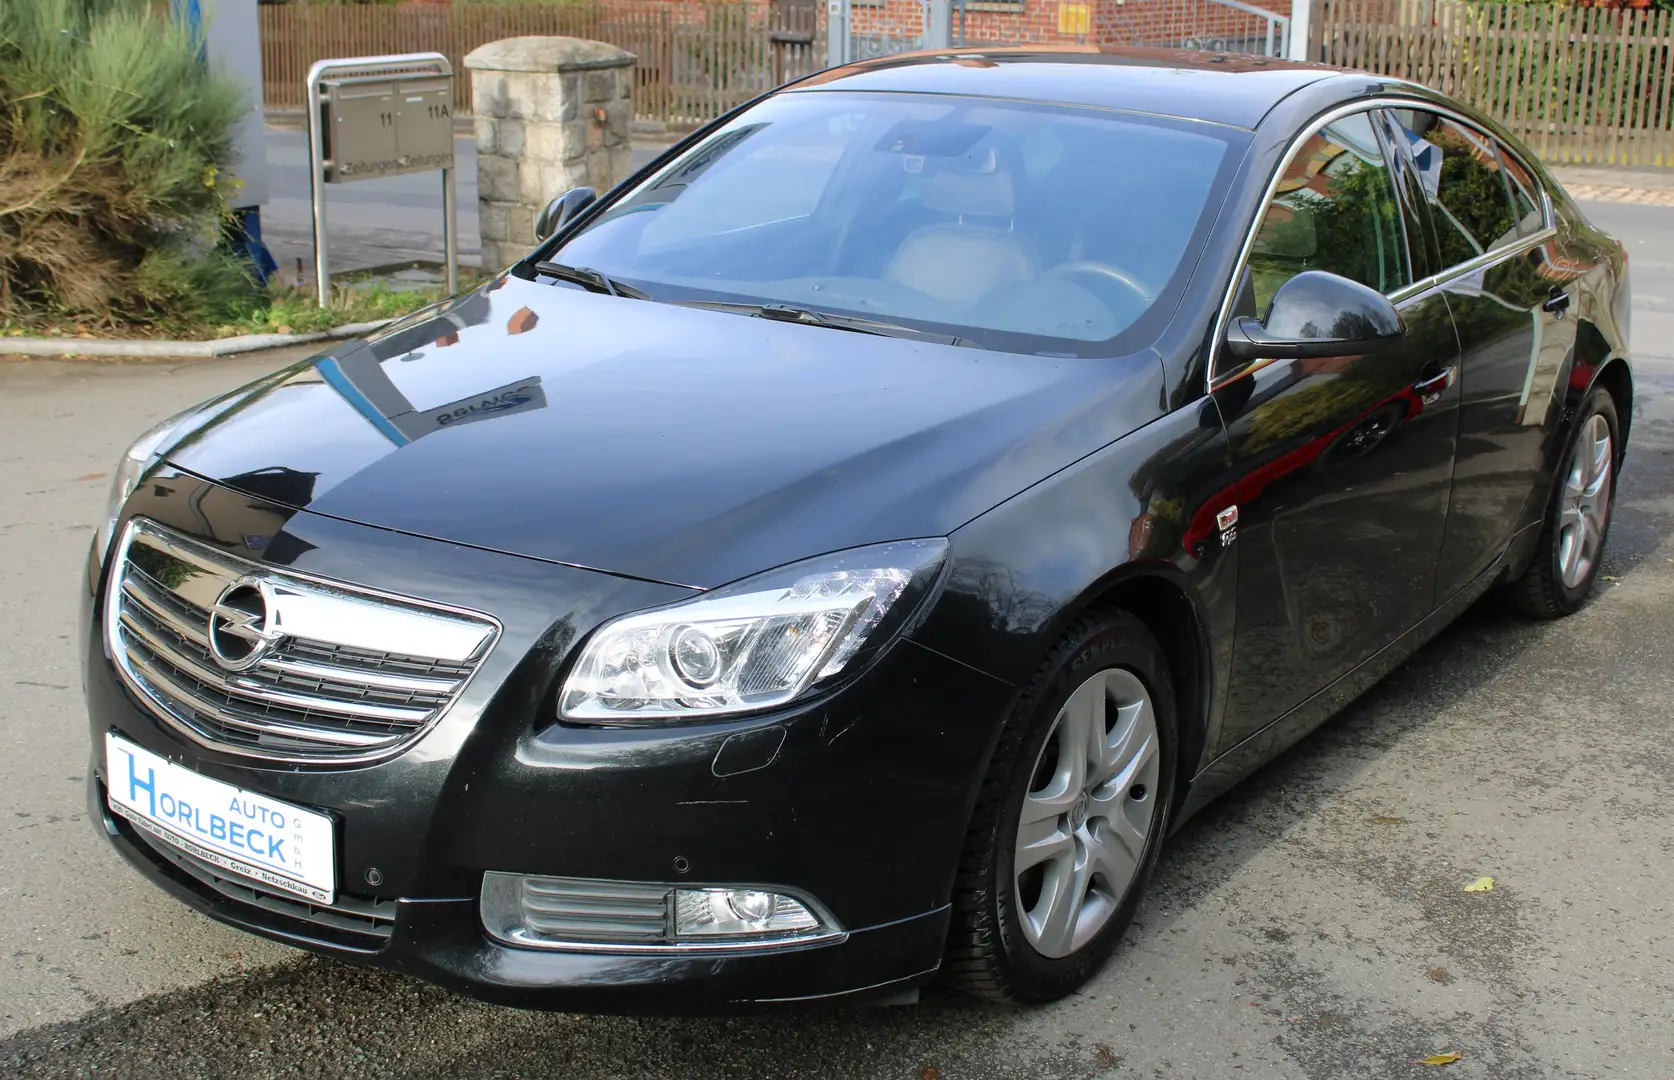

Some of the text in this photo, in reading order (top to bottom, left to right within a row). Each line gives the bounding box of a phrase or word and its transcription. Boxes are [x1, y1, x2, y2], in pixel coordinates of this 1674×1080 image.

[428, 104, 449, 119] 11A
[381, 112, 392, 127] 11
[343, 160, 397, 175] Zeitungen
[402, 153, 453, 168] Zeitungen
[118, 747, 286, 863] HORLBECK
[229, 797, 285, 829] AUTO
[164, 832, 180, 844] AUTO
[184, 844, 220, 863] HORLBECK
[230, 861, 252, 875] Greiz
[261, 872, 308, 894] Netzschkau
